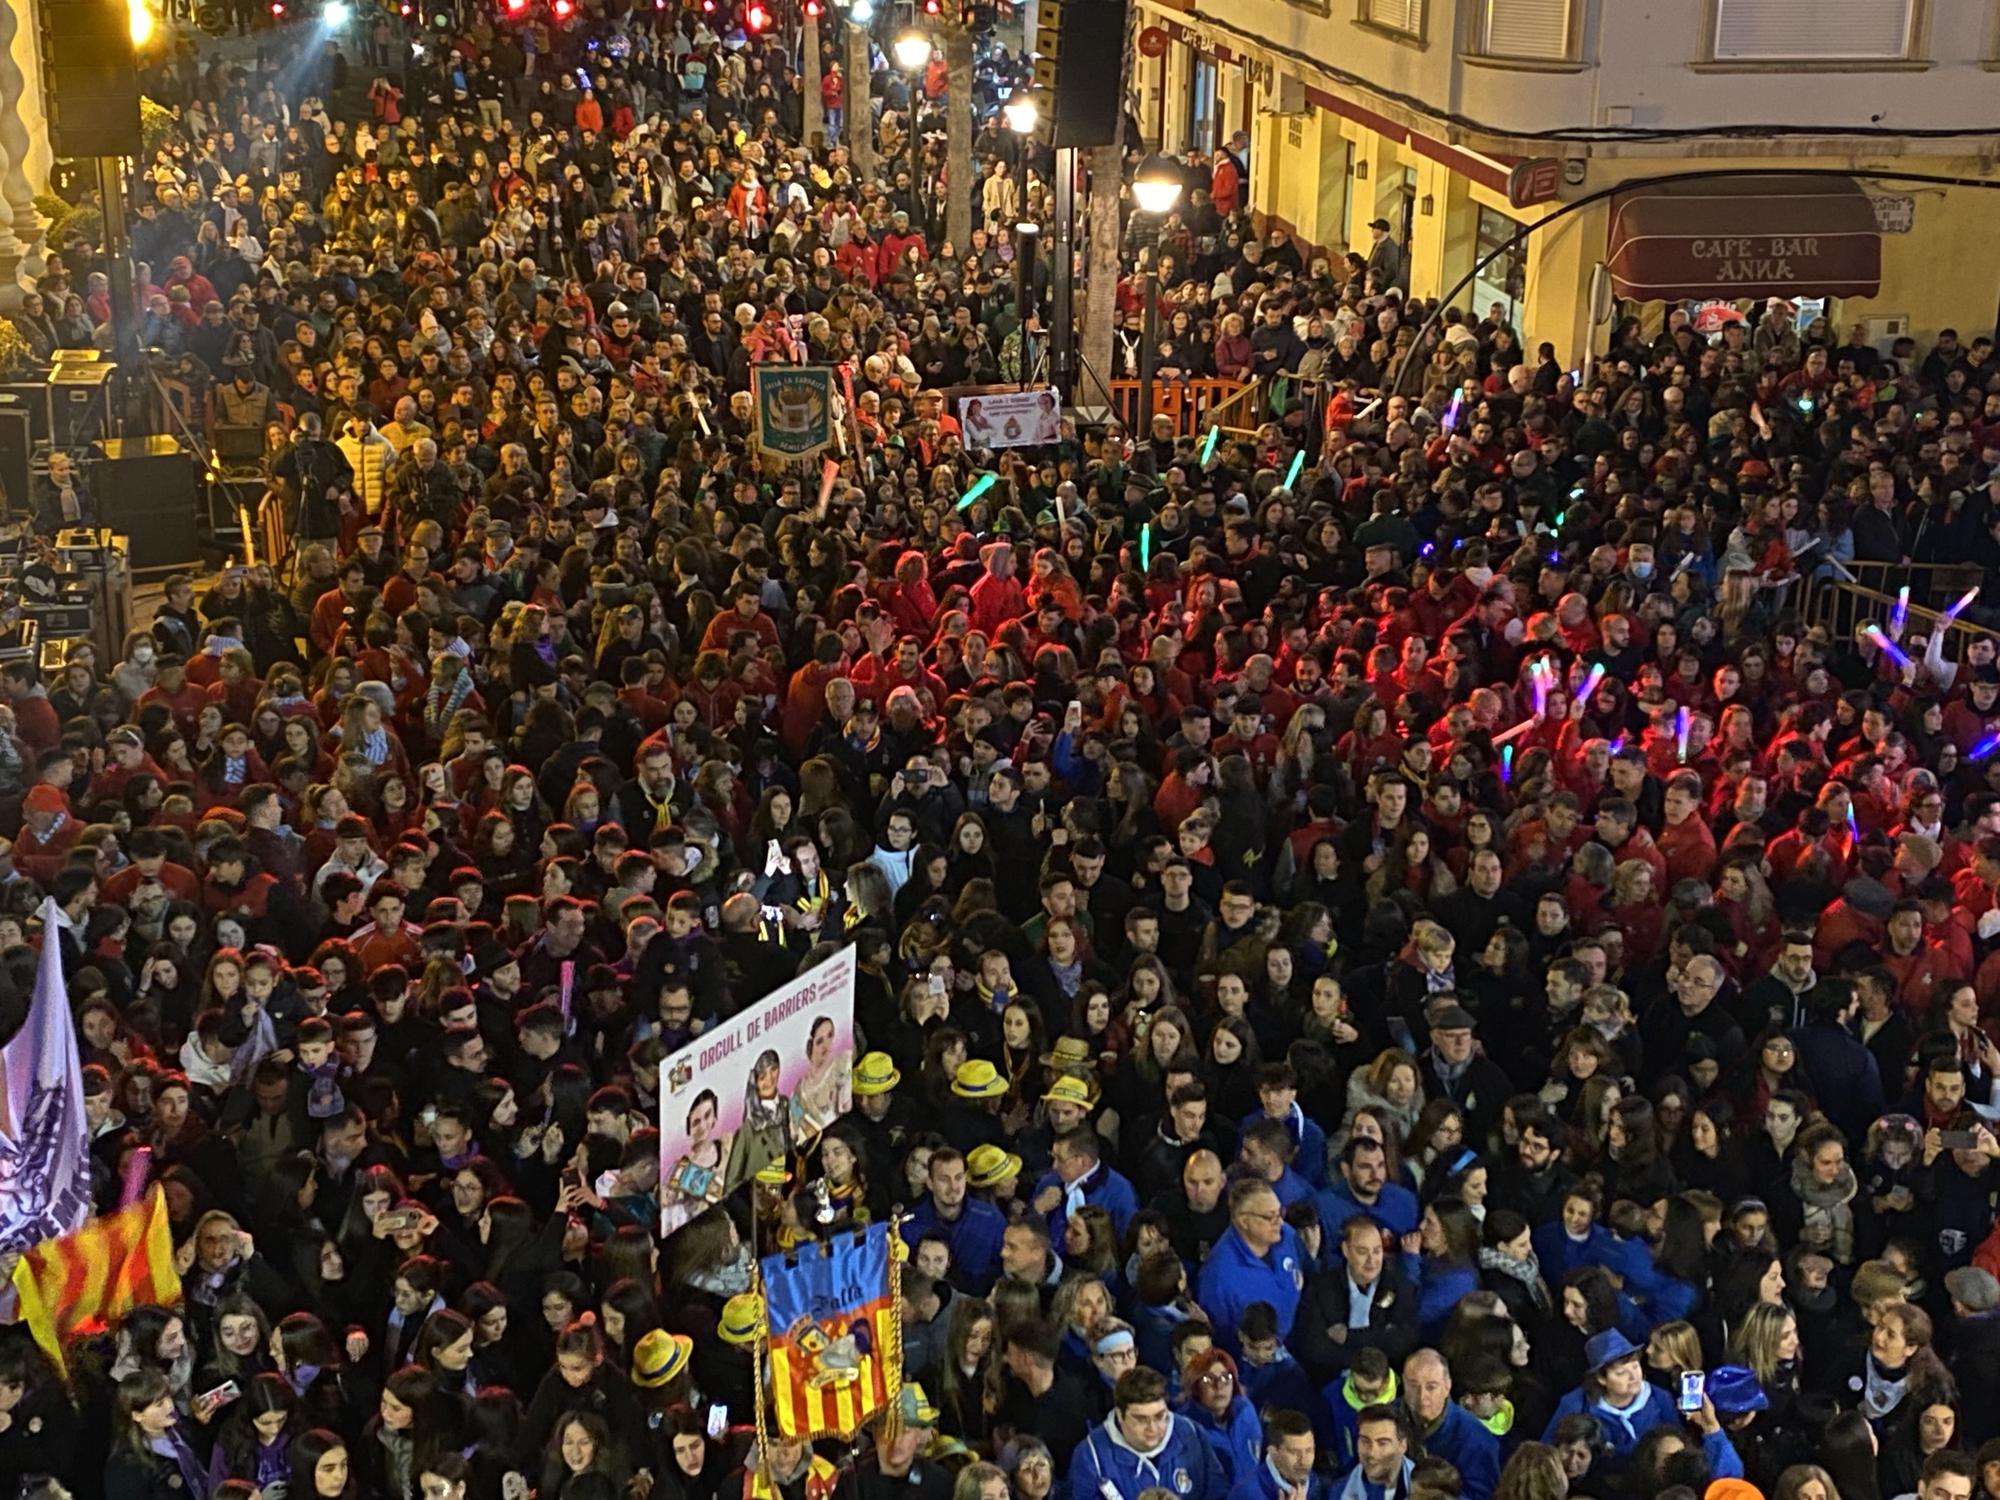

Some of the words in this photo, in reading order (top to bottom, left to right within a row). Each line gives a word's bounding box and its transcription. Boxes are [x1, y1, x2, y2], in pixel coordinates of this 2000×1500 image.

[1691, 239, 1752, 258] CAFE
[1771, 237, 1819, 257] BAR
[747, 1017, 761, 1043] DE
[764, 983, 816, 1032] BARRIERS
